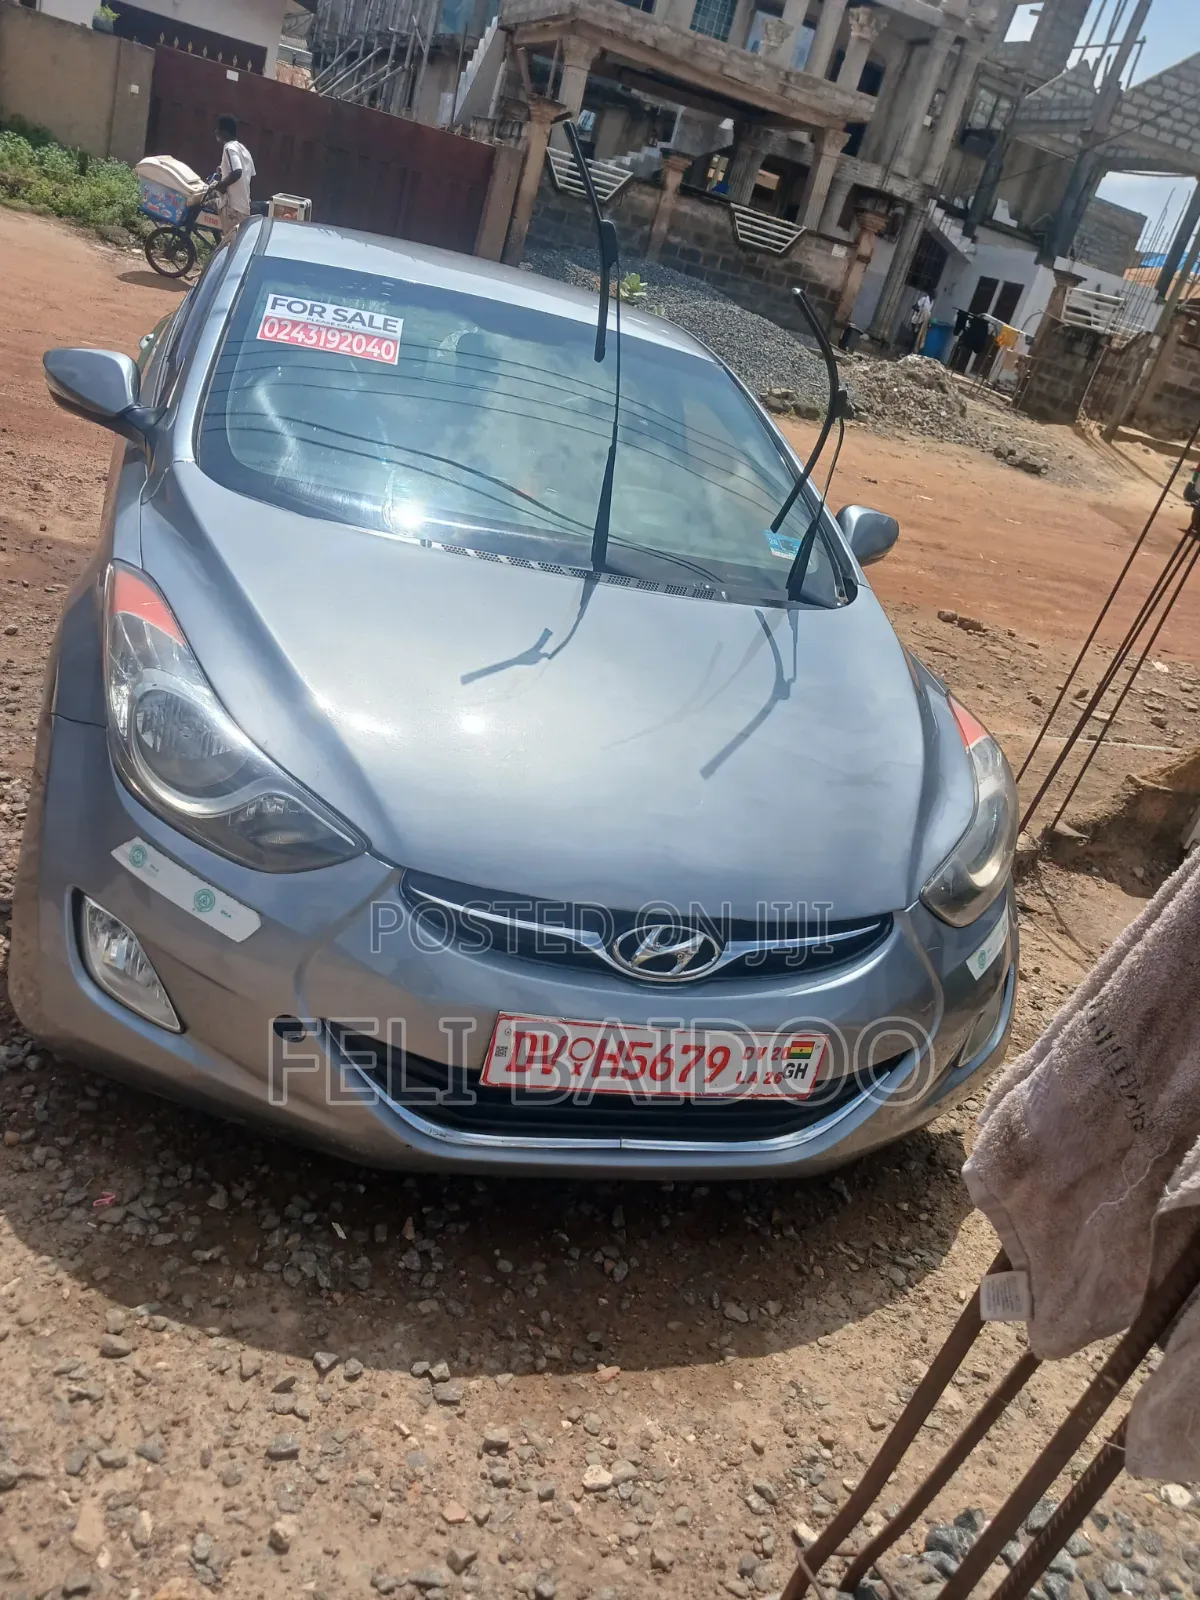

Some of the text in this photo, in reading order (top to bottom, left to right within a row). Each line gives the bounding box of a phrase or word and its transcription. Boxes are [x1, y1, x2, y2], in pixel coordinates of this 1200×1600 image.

[270, 297, 399, 334] FOR SALE
[263, 318, 395, 361] 0243192040
[505, 1030, 569, 1075] DV
[591, 1038, 732, 1085] H5679
[743, 1046, 768, 1060] DV
[736, 1070, 758, 1085] LA
[782, 1062, 809, 1080] GH
